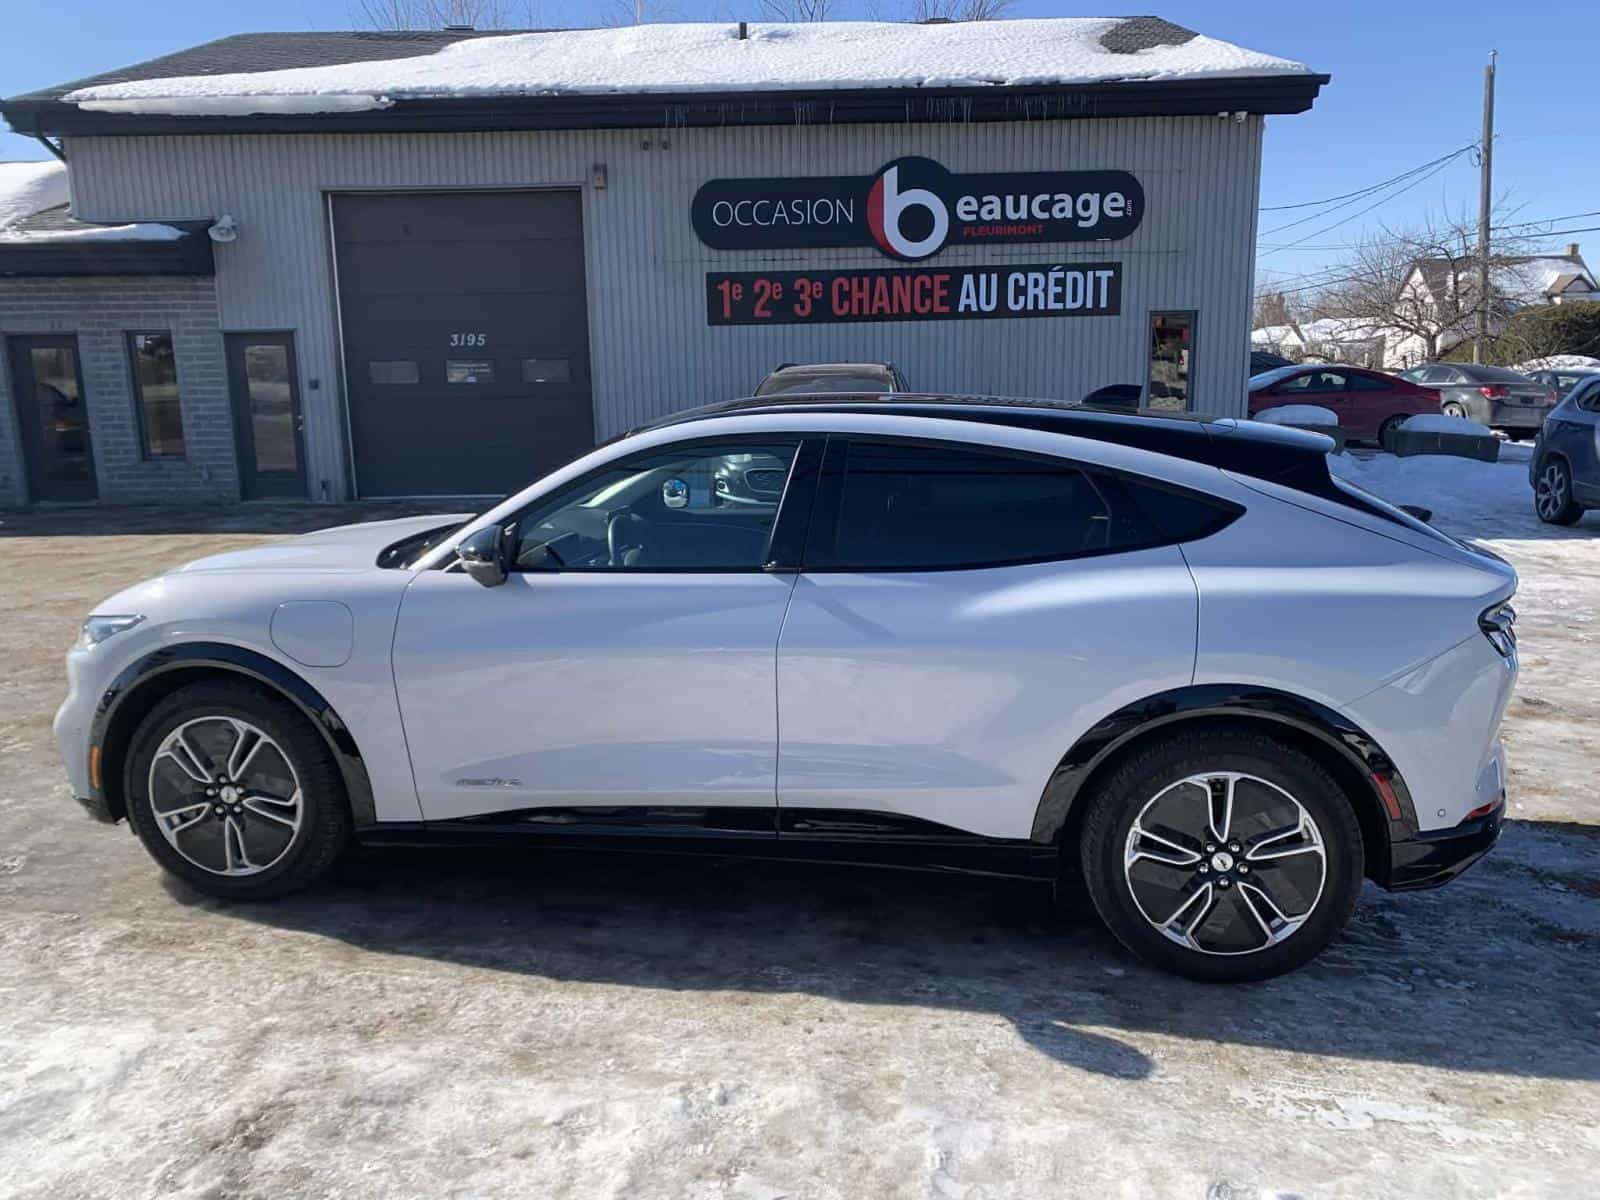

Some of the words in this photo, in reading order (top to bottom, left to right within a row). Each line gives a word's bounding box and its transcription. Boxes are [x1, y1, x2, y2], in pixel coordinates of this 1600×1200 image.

[712, 199, 854, 226] OCCASION
[963, 223, 1045, 237] FLEURIMONT
[831, 273, 950, 317] CHANCE
[958, 272, 998, 312] AU
[1007, 265, 1114, 311] CRÉDIT
[450, 333, 487, 347] 3195
